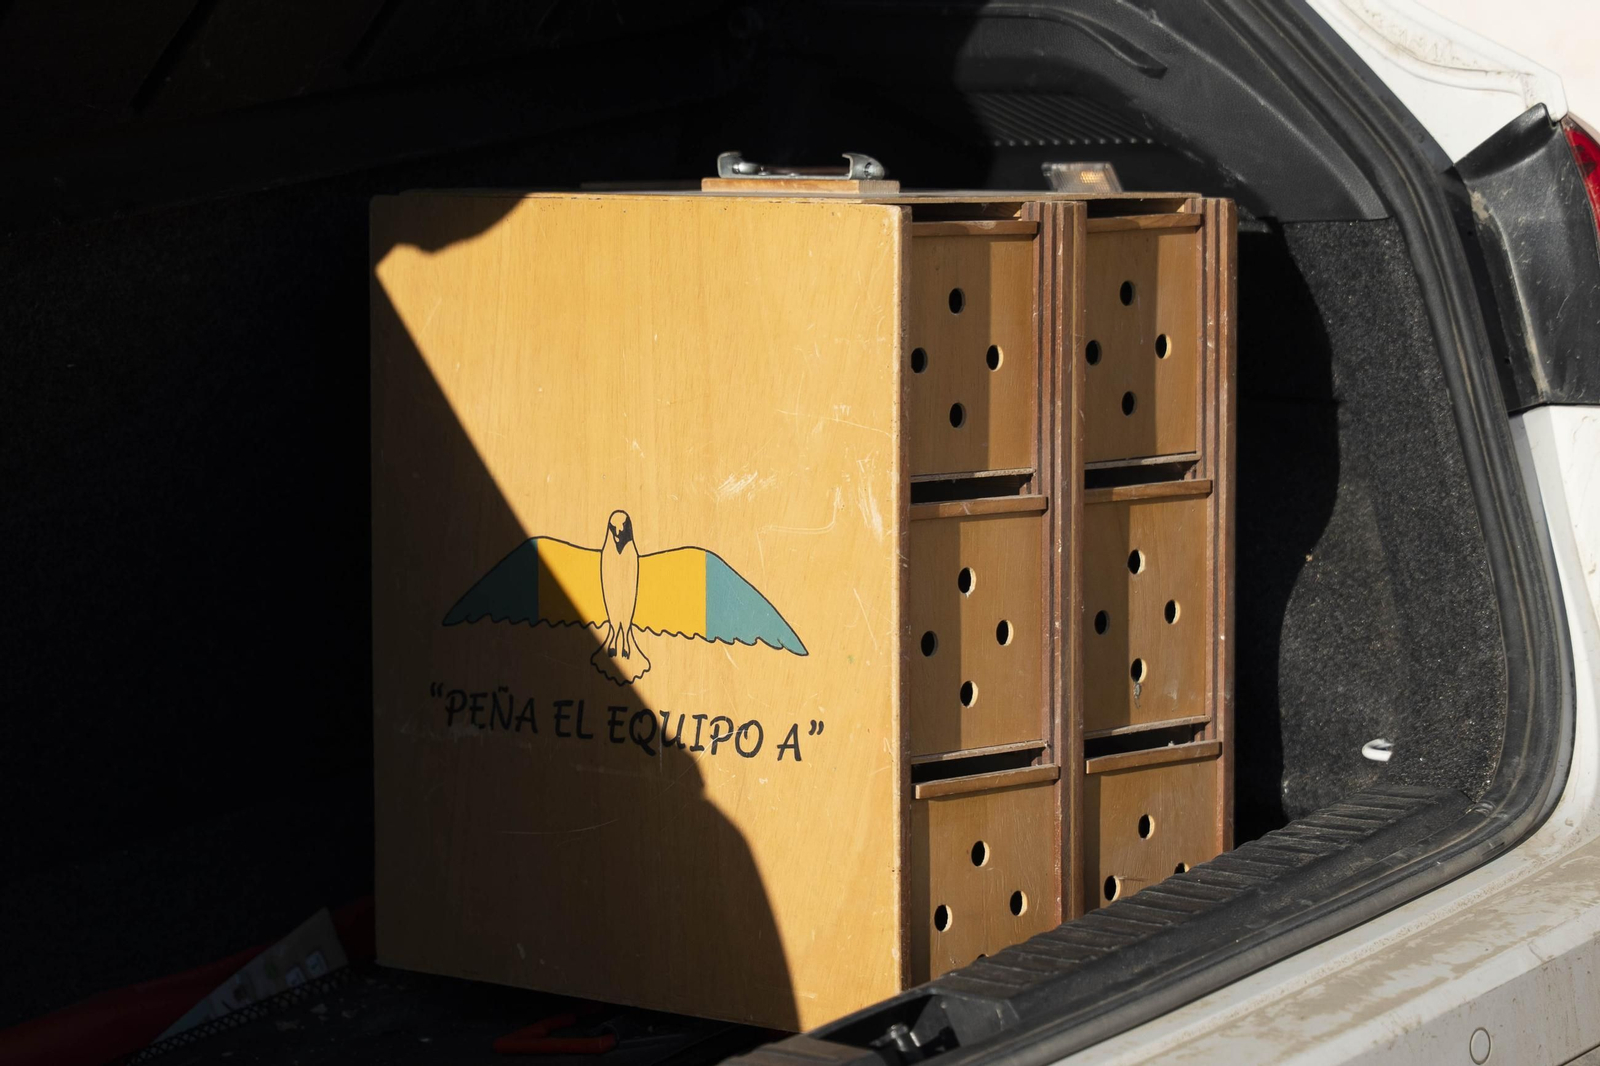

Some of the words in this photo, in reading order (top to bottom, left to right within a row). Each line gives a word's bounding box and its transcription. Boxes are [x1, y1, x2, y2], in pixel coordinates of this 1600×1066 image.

[430, 682, 539, 734] “PEÑA
[553, 699, 593, 740] EL
[607, 706, 764, 758] EQUIPO
[777, 720, 824, 761] A”
